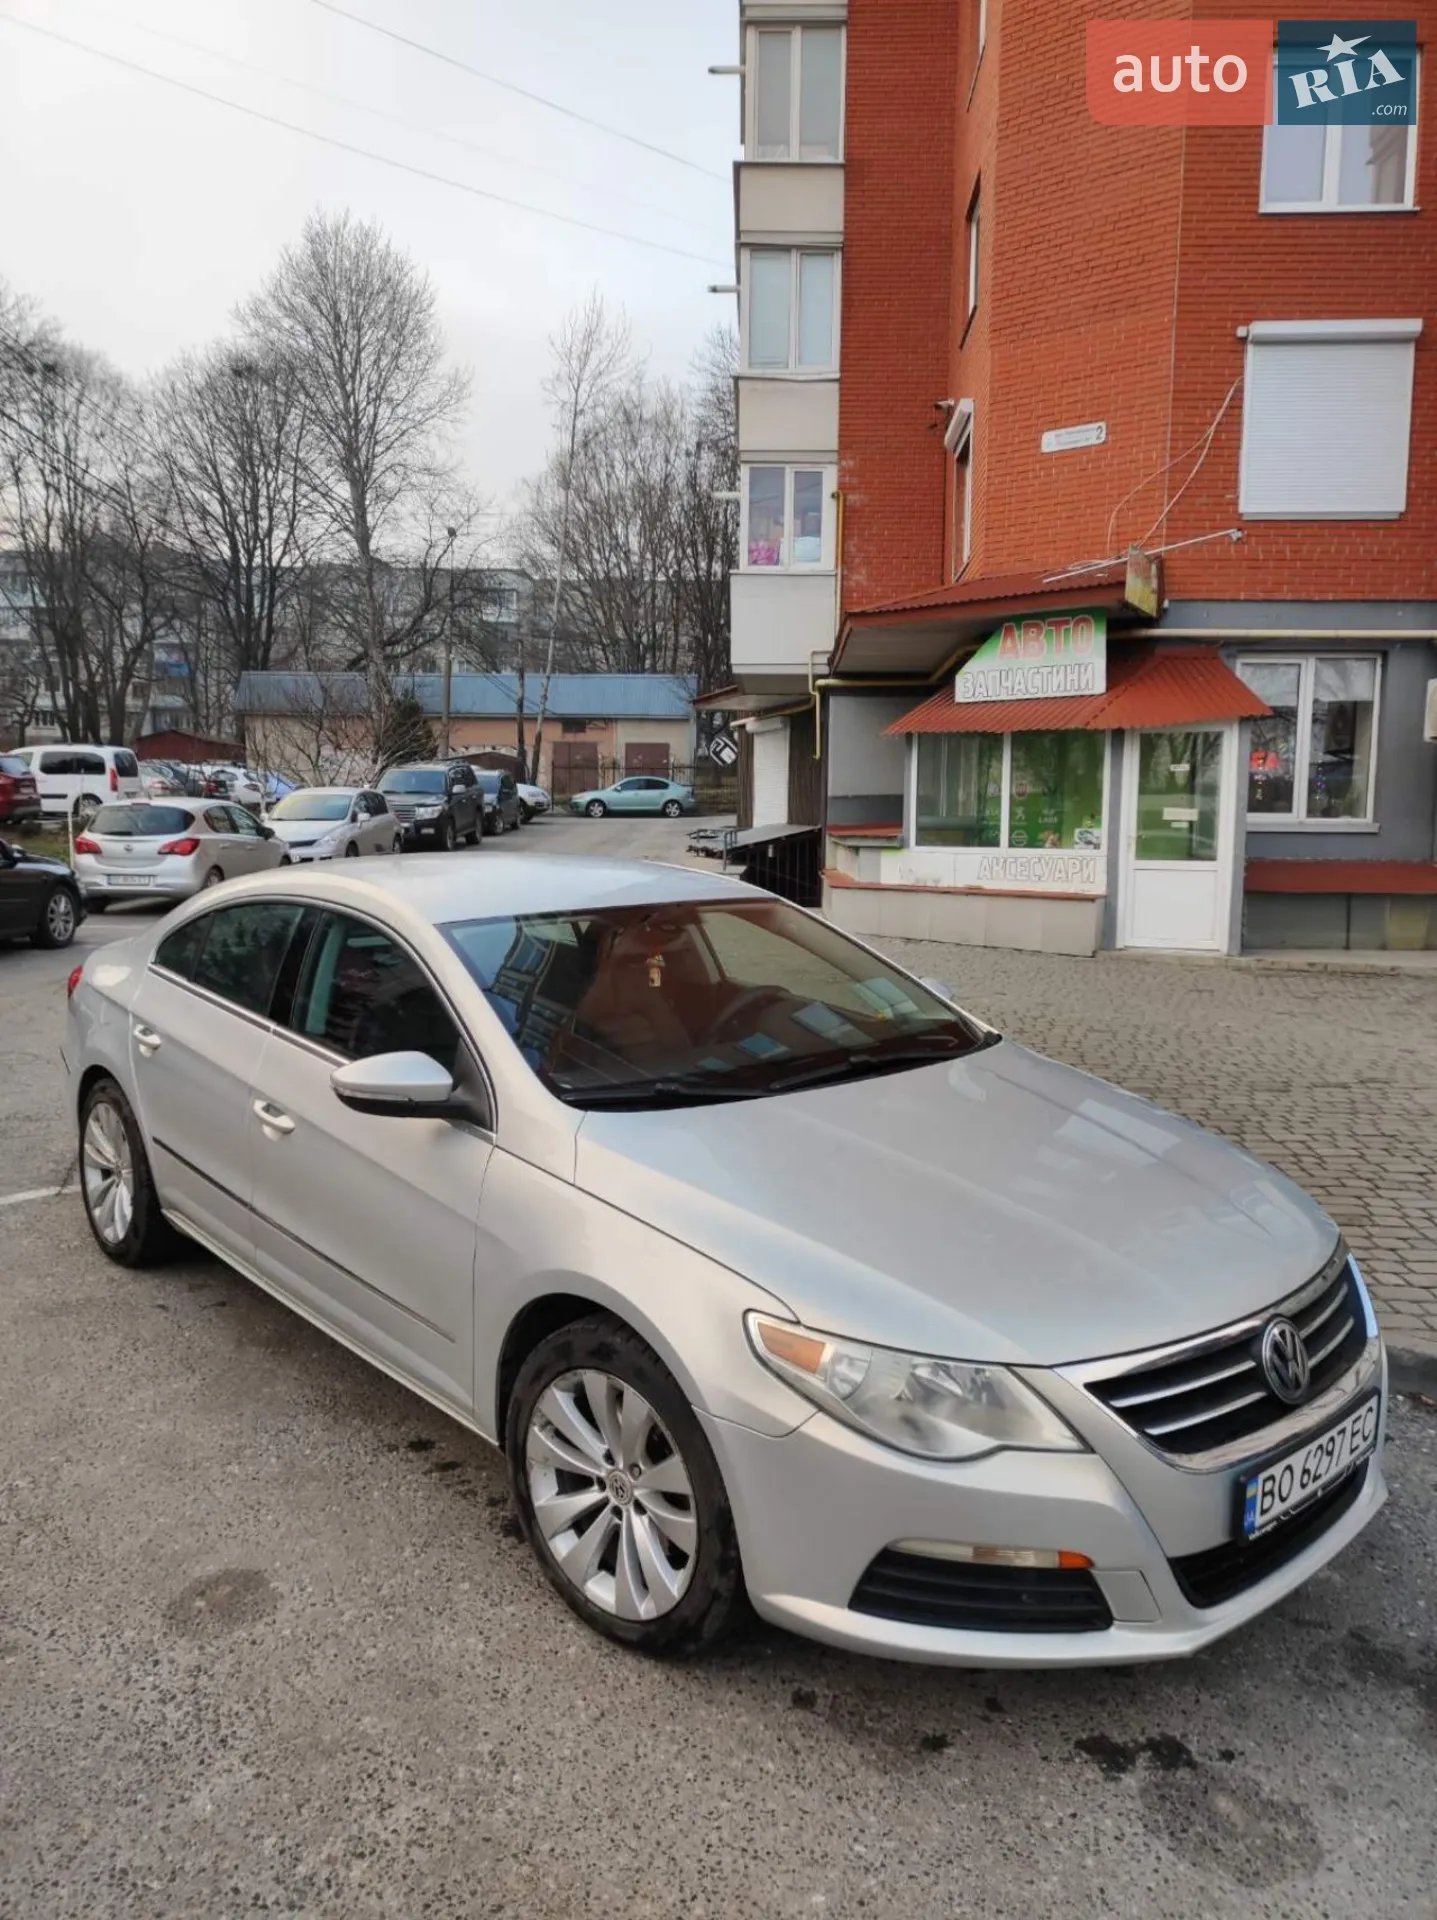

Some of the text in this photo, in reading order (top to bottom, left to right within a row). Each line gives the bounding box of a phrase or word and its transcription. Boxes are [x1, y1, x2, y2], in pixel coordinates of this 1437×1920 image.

[1095, 425, 1104, 441] 2
[998, 614, 1096, 660] АВТО
[961, 662, 1096, 699] ЗАПЧАСТИНИ
[977, 856, 1097, 884] АКСЕСУАРИ
[1260, 1406, 1374, 1517] BO 6297 EC
